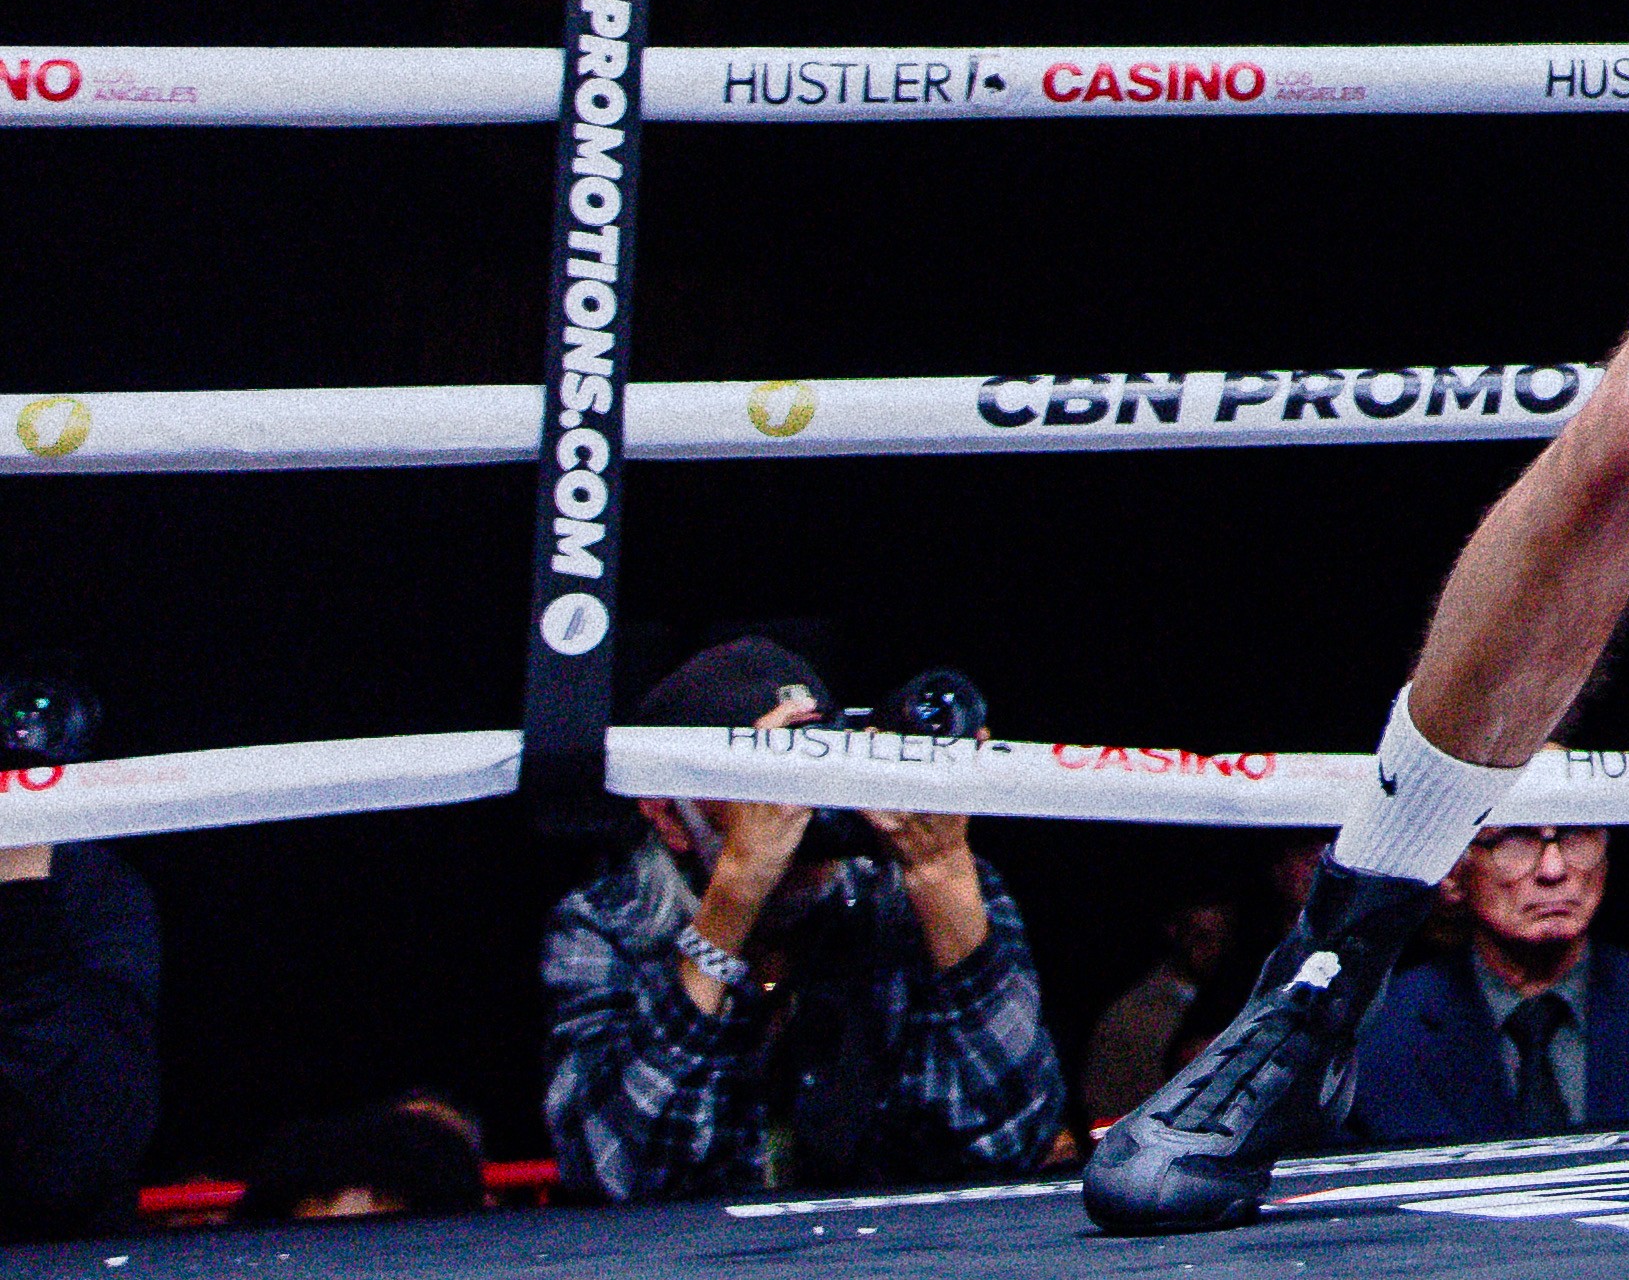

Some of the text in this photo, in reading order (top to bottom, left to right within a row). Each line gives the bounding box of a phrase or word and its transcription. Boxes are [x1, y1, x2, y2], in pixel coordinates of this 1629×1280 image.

[723, 61, 1266, 104] HUSTLER CASINO
[977, 372, 1193, 428] CBN
